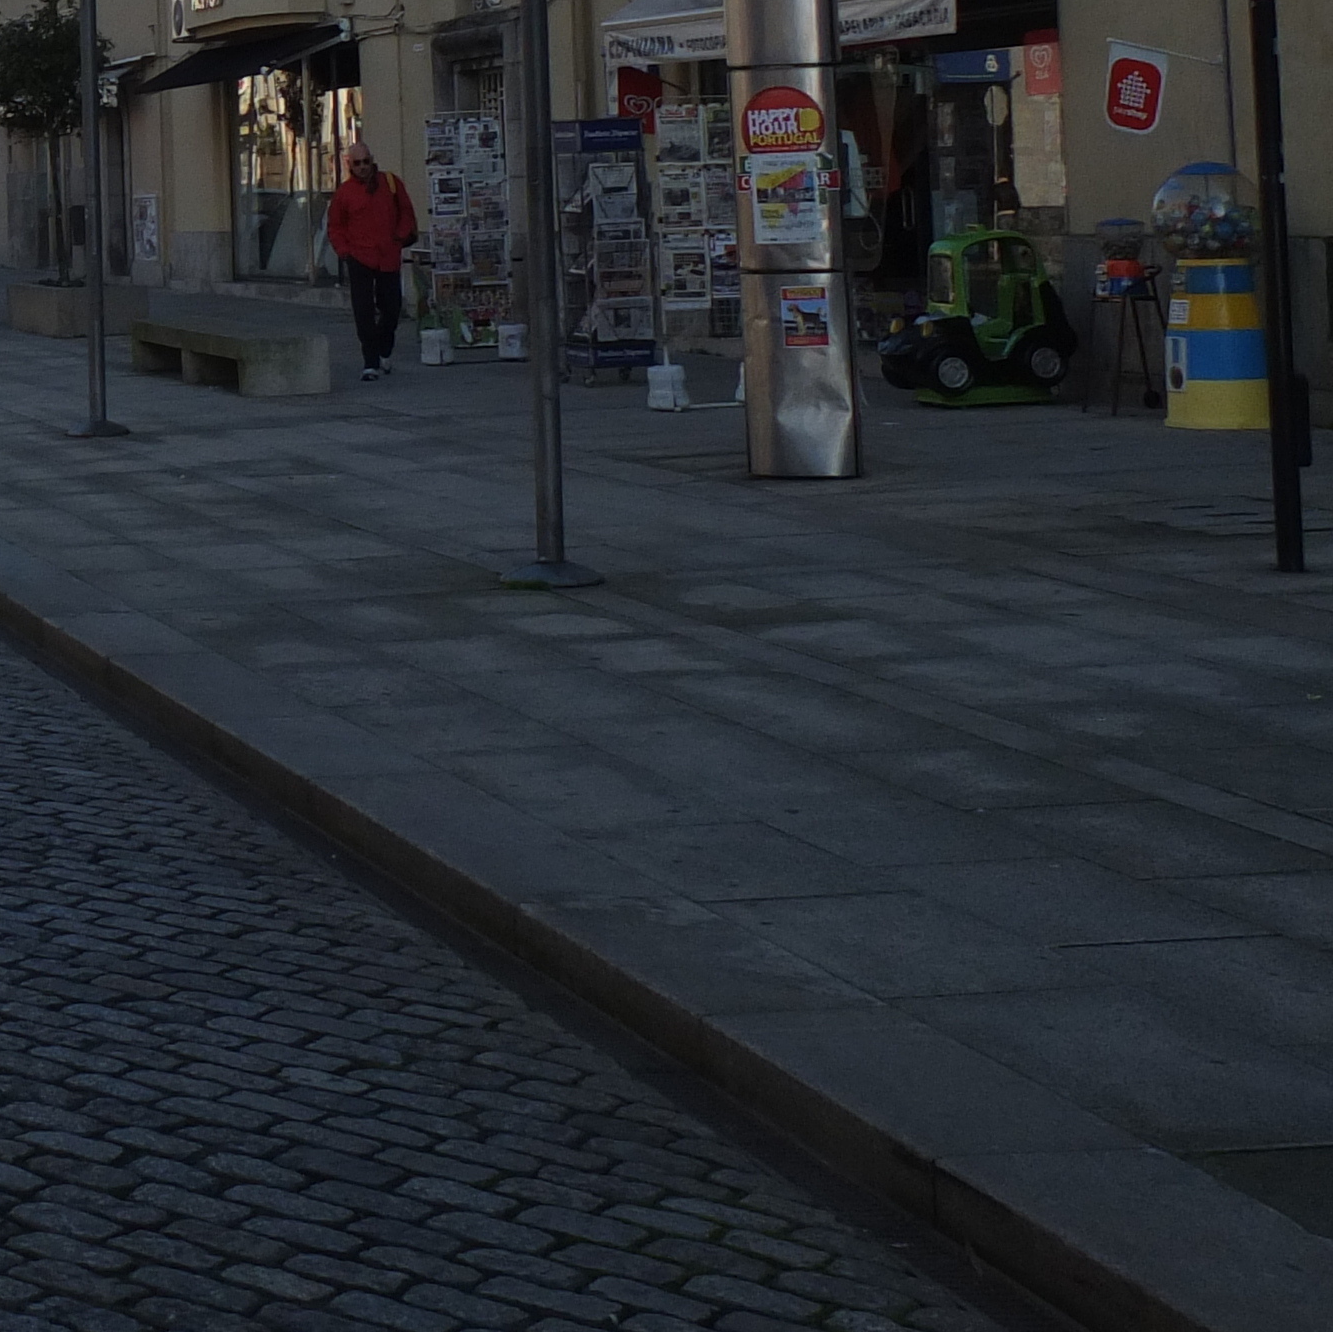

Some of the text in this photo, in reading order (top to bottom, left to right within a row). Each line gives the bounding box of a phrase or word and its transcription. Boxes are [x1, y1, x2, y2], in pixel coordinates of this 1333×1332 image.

[747, 108, 797, 123] HAPPY
[749, 121, 798, 136] HOUR
[750, 132, 822, 147] PORTUGAL
